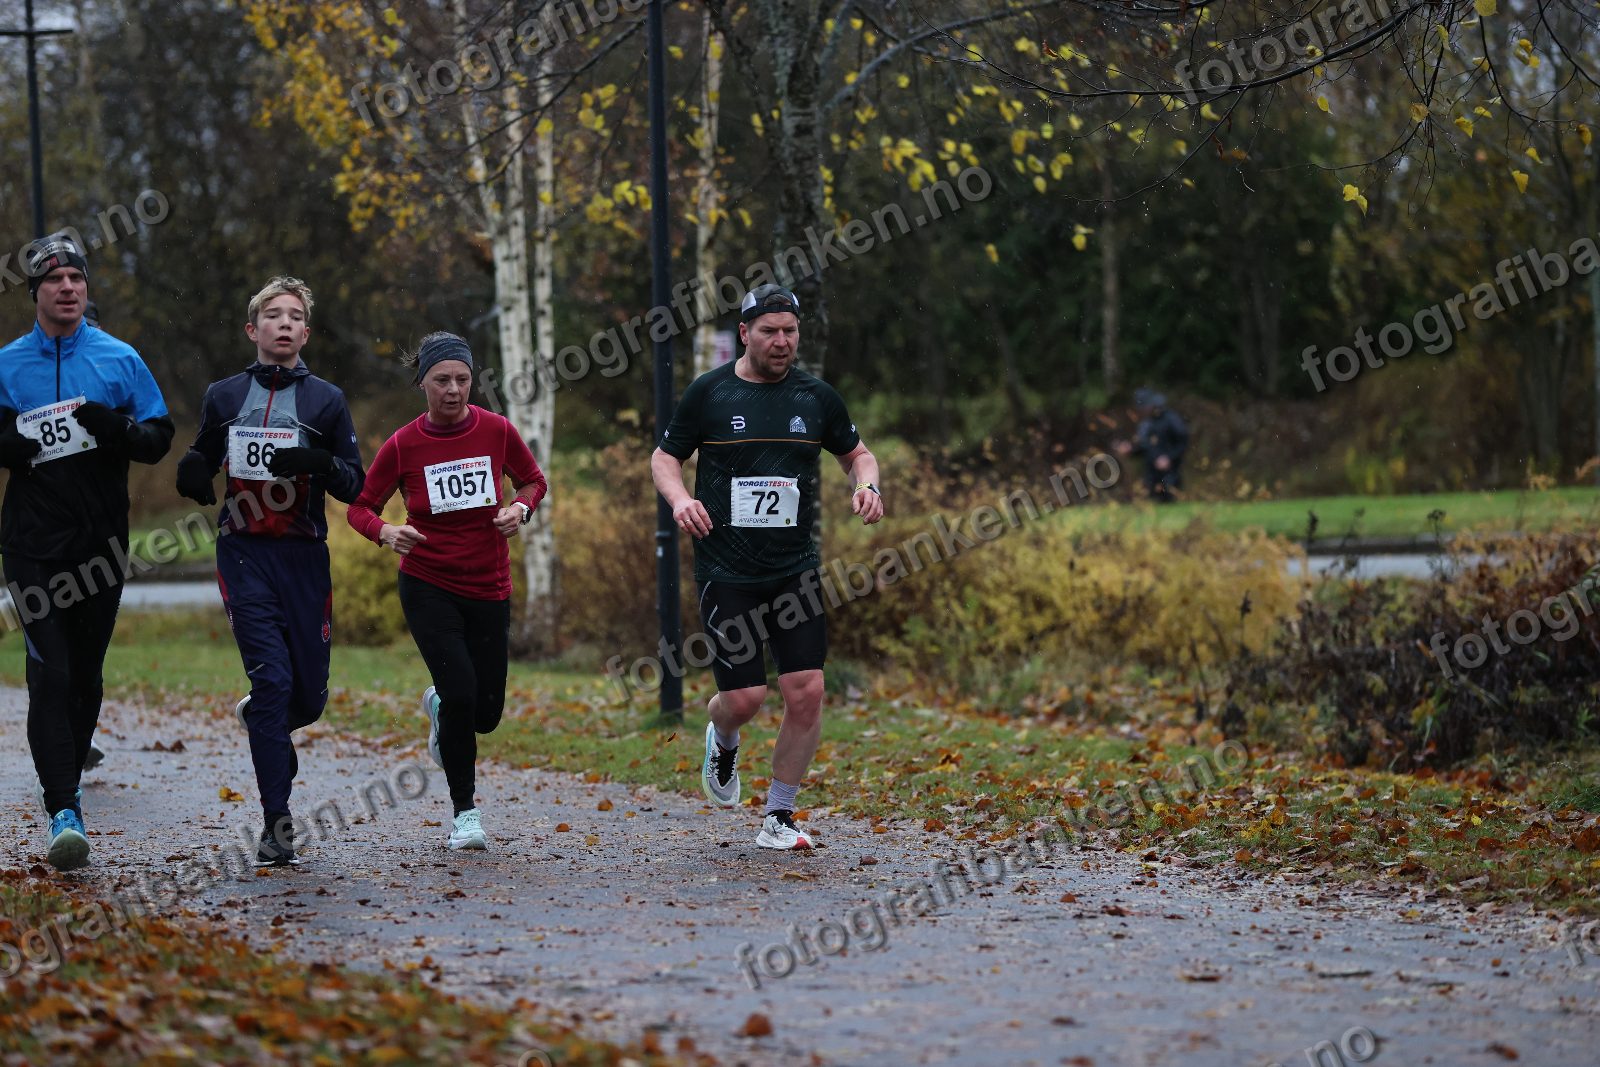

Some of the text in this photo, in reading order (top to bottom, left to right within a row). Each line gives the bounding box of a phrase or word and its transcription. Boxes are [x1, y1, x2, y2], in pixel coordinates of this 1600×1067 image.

[22, 402, 80, 424] NORGESTESTEN
[40, 417, 71, 447] 85
[236, 430, 293, 439] NORGESTESTEN
[247, 442, 276, 468] 86
[430, 460, 487, 475] NORGESTESTEN
[434, 470, 488, 500] 1057
[751, 490, 780, 515] 72
